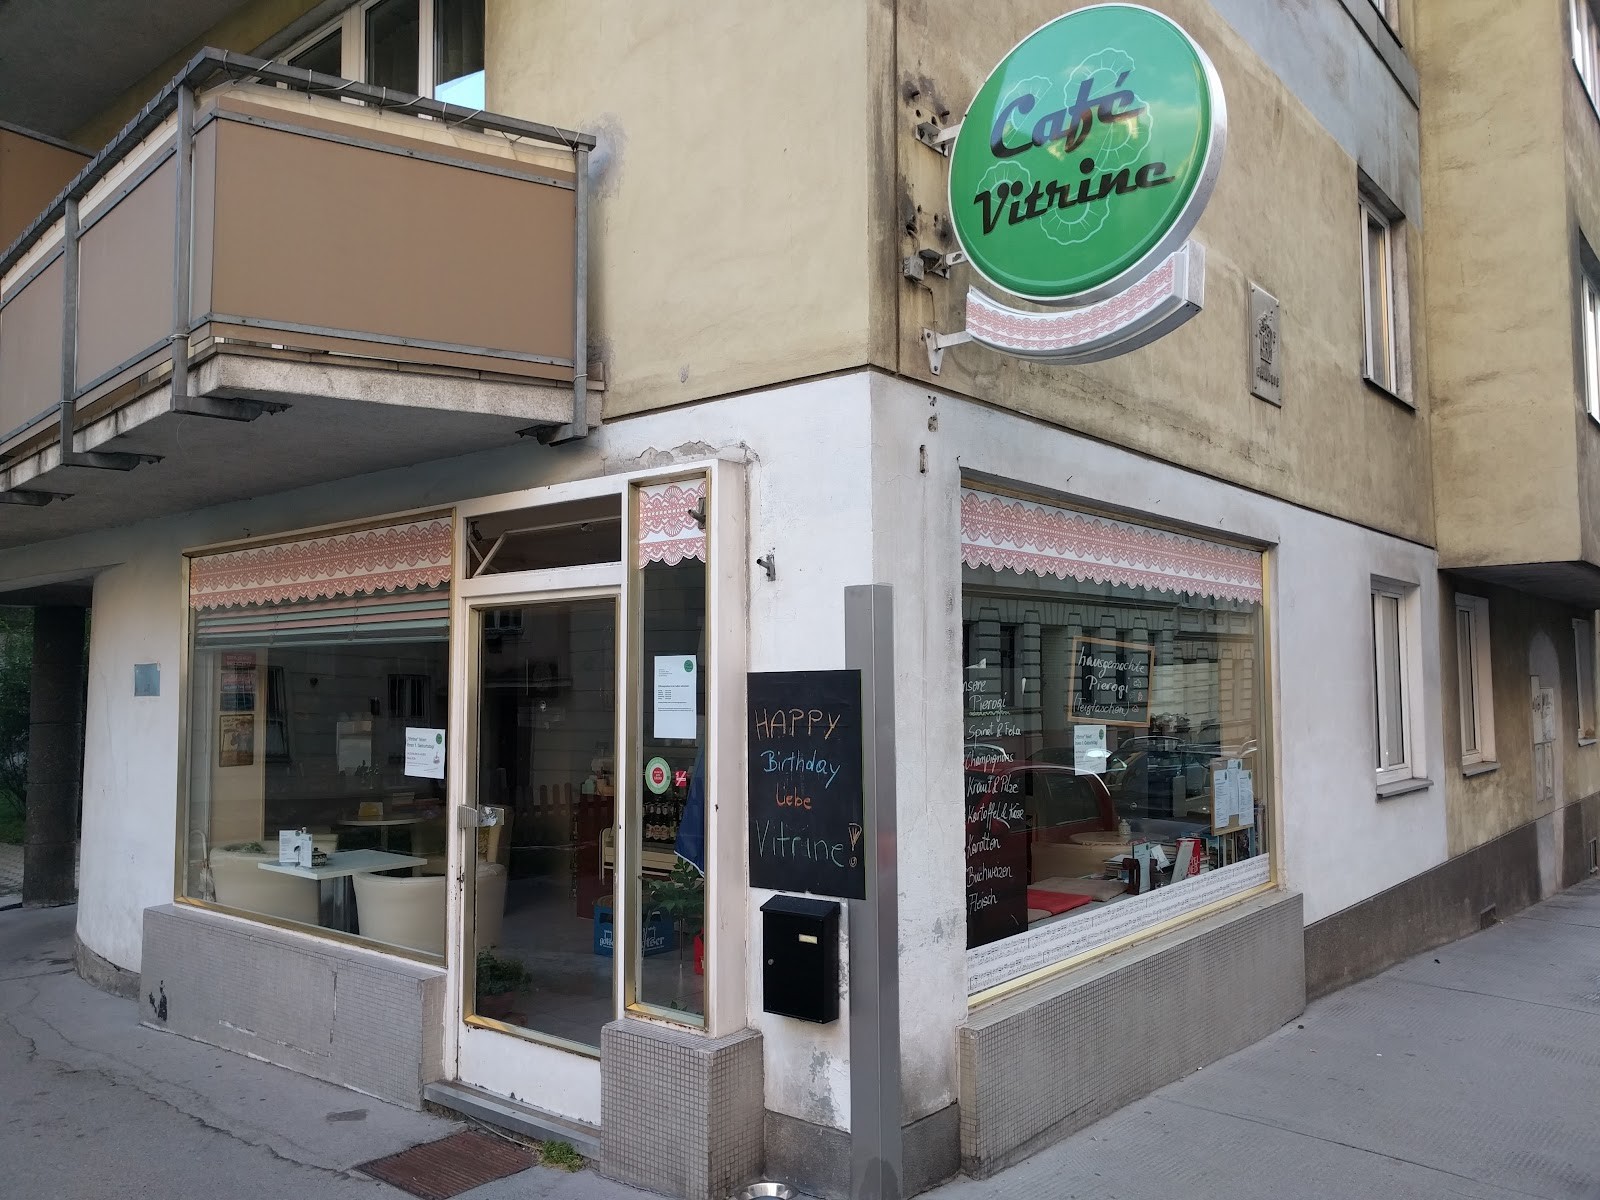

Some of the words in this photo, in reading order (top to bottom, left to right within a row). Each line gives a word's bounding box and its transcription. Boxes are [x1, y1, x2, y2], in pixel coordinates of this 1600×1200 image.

[990, 70, 1146, 158] Café
[973, 157, 1176, 235] Vitrine
[962, 680, 987, 692] nsere
[1085, 675, 1131, 699] Pierogi
[968, 692, 1008, 722] Pierogi
[754, 708, 842, 741] HAPPY
[760, 749, 841, 789] Birthday
